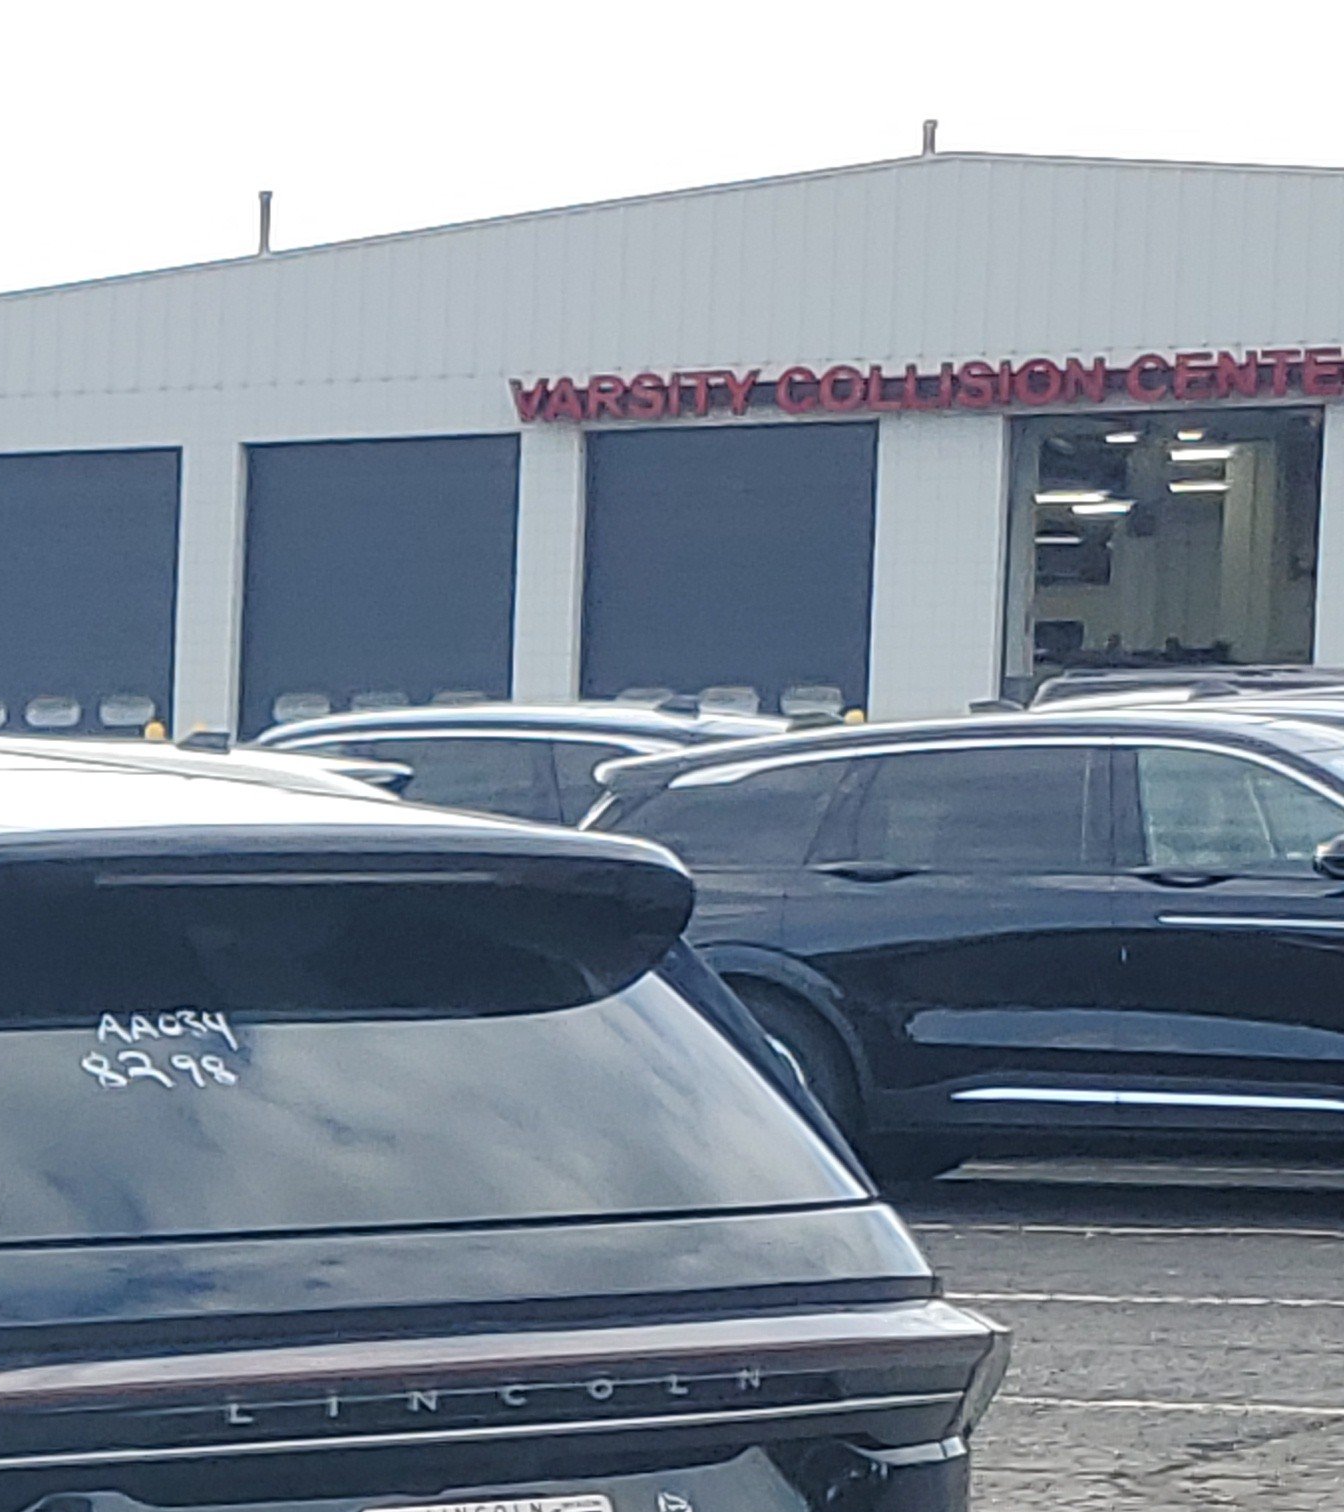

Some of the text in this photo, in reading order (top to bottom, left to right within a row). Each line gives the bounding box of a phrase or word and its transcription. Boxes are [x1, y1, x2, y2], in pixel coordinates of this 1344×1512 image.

[510, 368, 759, 423] VARSITY
[776, 356, 1105, 415] COLLISION
[81, 1050, 239, 1088] 8298
[226, 1367, 763, 1424] LINCOLN
